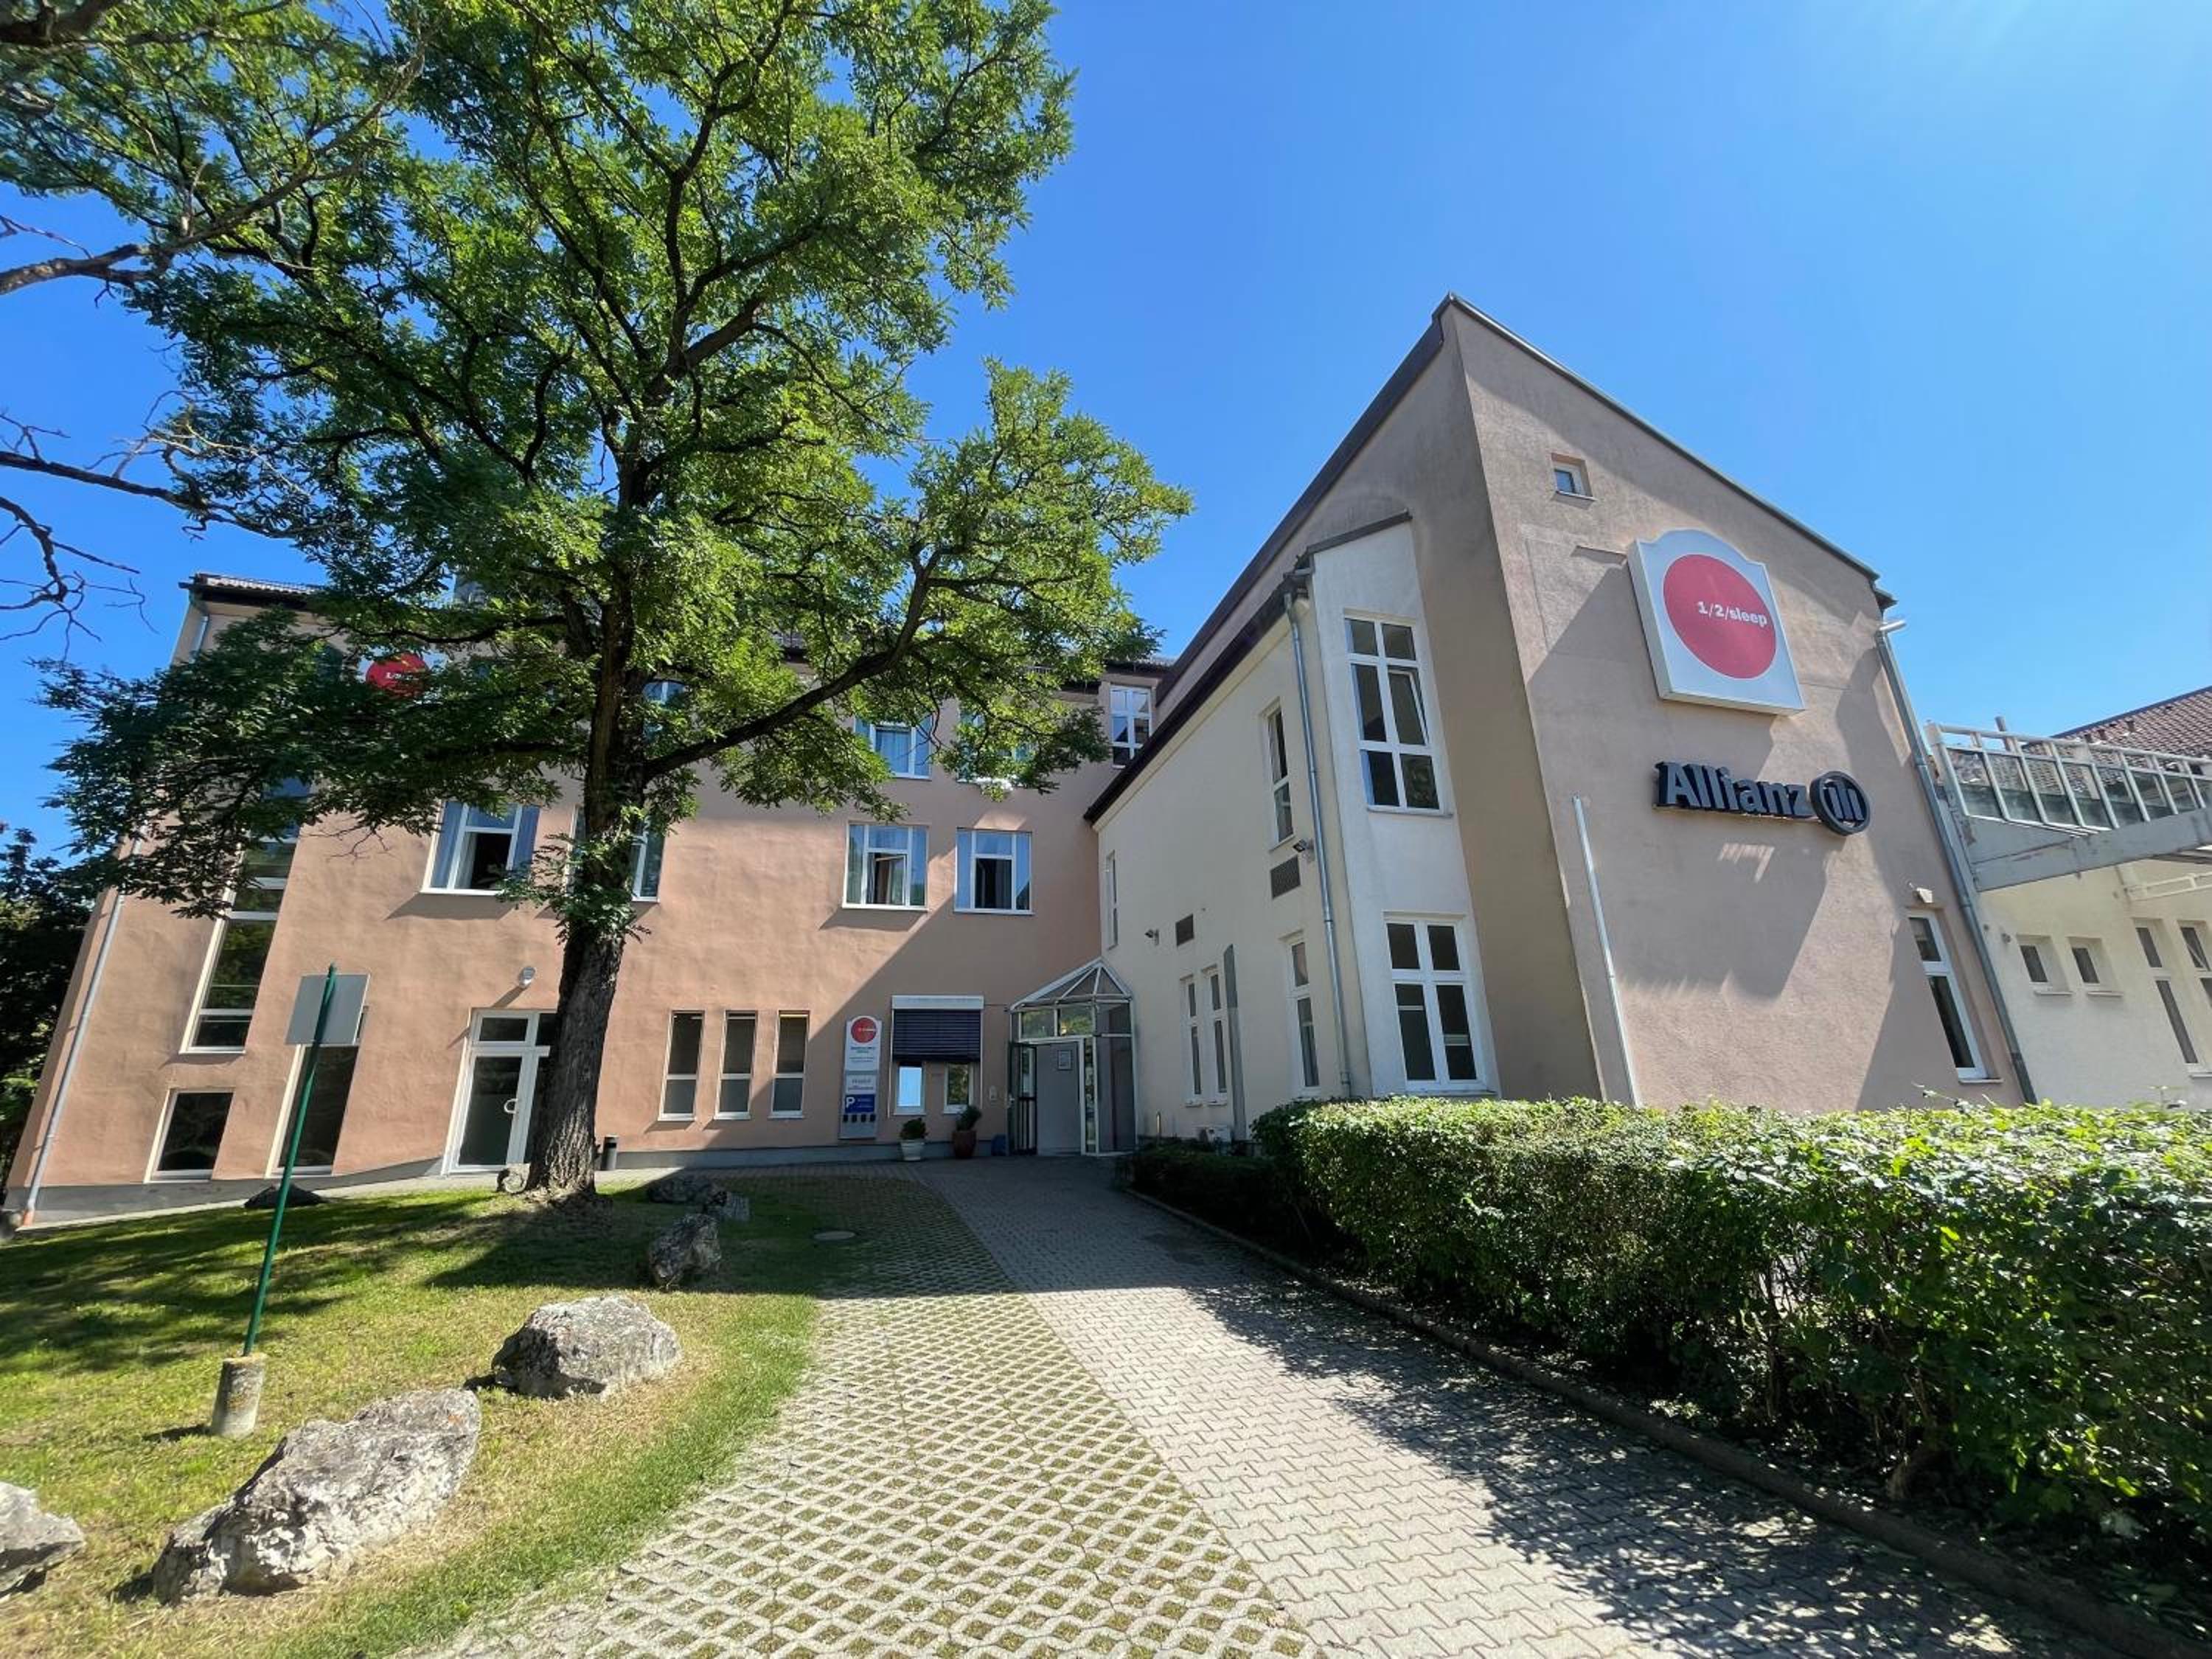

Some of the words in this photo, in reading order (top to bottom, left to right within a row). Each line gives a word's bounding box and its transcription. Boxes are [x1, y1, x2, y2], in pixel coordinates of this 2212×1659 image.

[1698, 601, 1767, 627] 1/2/sleep
[1654, 761, 1815, 818] Allianz
[846, 1096, 855, 1108] P
